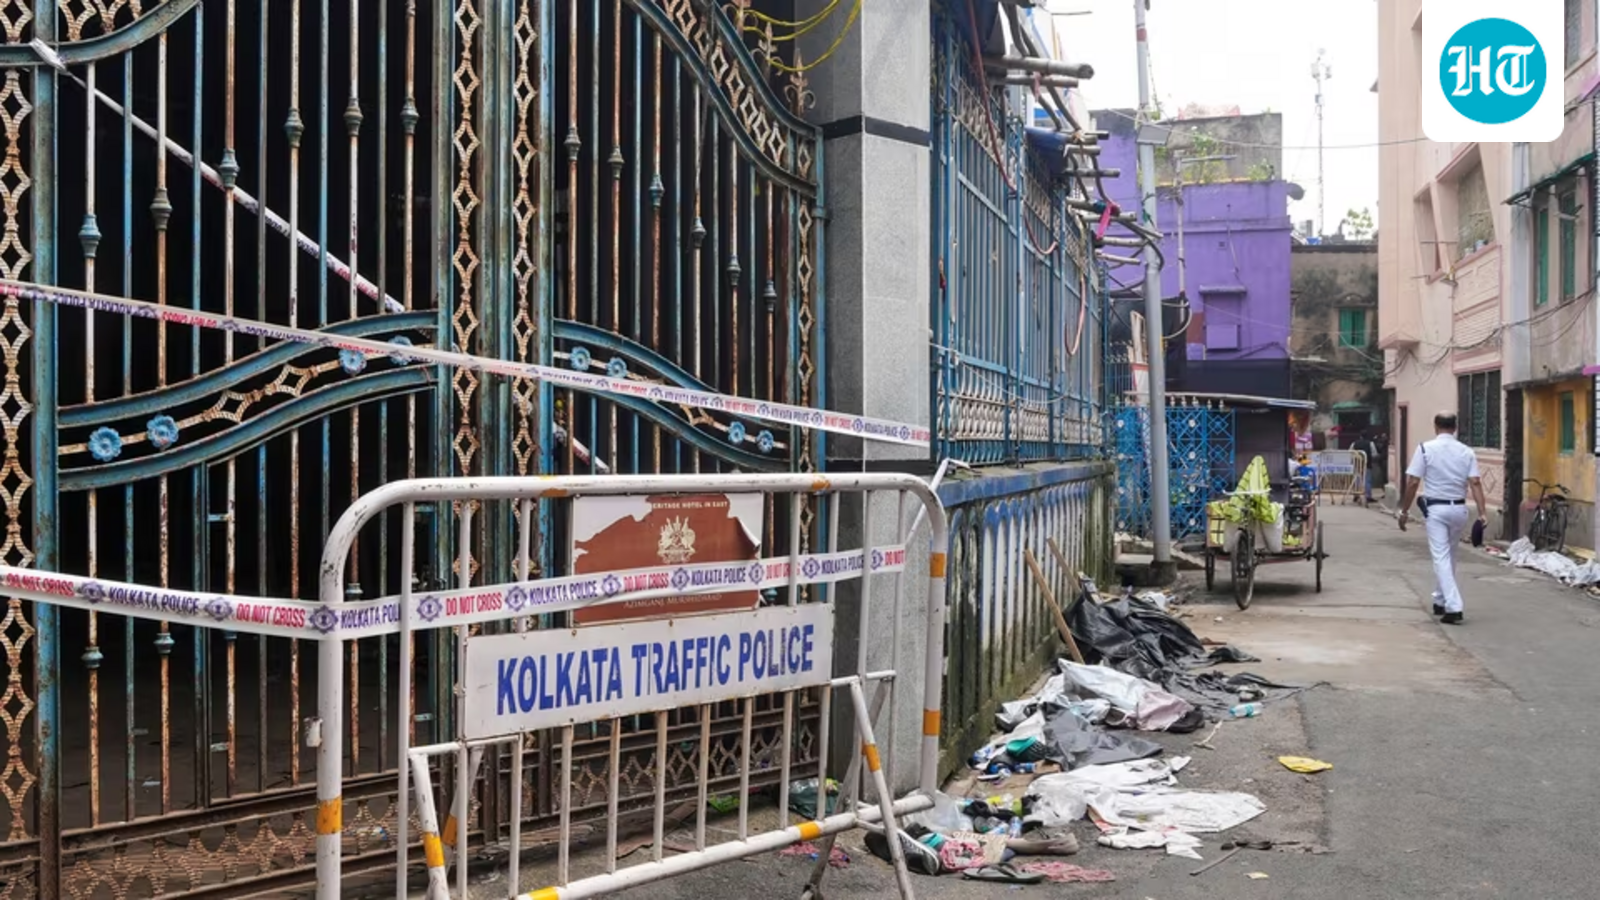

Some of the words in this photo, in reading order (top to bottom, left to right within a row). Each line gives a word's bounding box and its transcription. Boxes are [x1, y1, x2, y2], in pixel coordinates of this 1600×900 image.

[691, 568, 722, 586] KOLKATA
[724, 567, 746, 584] POLICE
[783, 562, 800, 577] CRS
[821, 558, 848, 575] KOLKATA
[529, 584, 568, 605] KOLKATA
[570, 580, 598, 600] POLICE
[623, 575, 634, 592] DO
[635, 574, 647, 591] NOT
[648, 573, 669, 589] CROSS
[109, 586, 159, 611] KOLKATA
[161, 594, 201, 615] POLICE
[446, 597, 457, 616] DO
[459, 595, 475, 614] NOT
[476, 592, 503, 611] CROSS
[236, 603, 250, 620] DO
[251, 604, 272, 624] NOT
[273, 606, 306, 628] CROSS
[341, 606, 381, 629] KOLKATA
[382, 603, 401, 624] POLI
[497, 646, 623, 715] KOLKATA
[632, 633, 731, 697] TRAFFIC
[738, 623, 814, 682] POLICE
